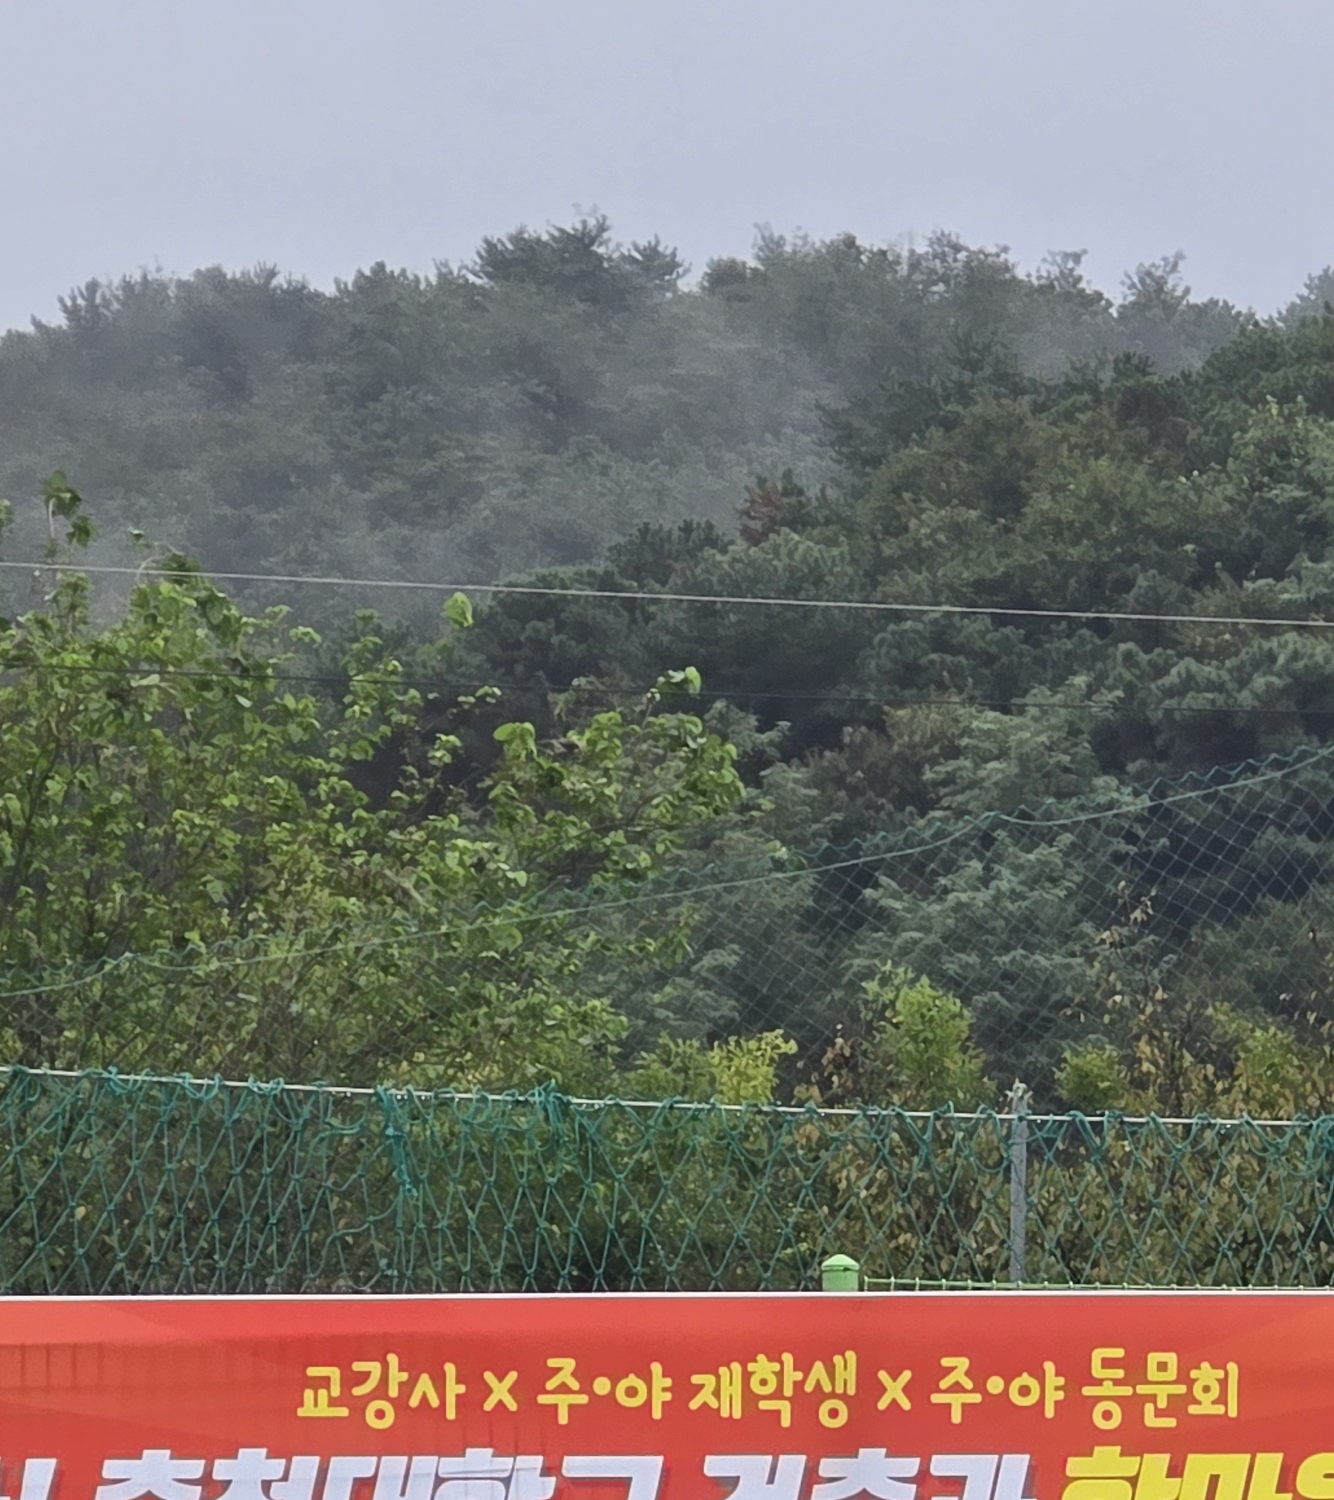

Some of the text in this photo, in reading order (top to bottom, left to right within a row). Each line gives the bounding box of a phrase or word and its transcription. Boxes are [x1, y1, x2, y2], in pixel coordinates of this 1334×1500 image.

[297, 1353, 465, 1429] 교강사
[689, 1350, 858, 1429] 재학생
[1081, 1347, 1240, 1431] 동문회
